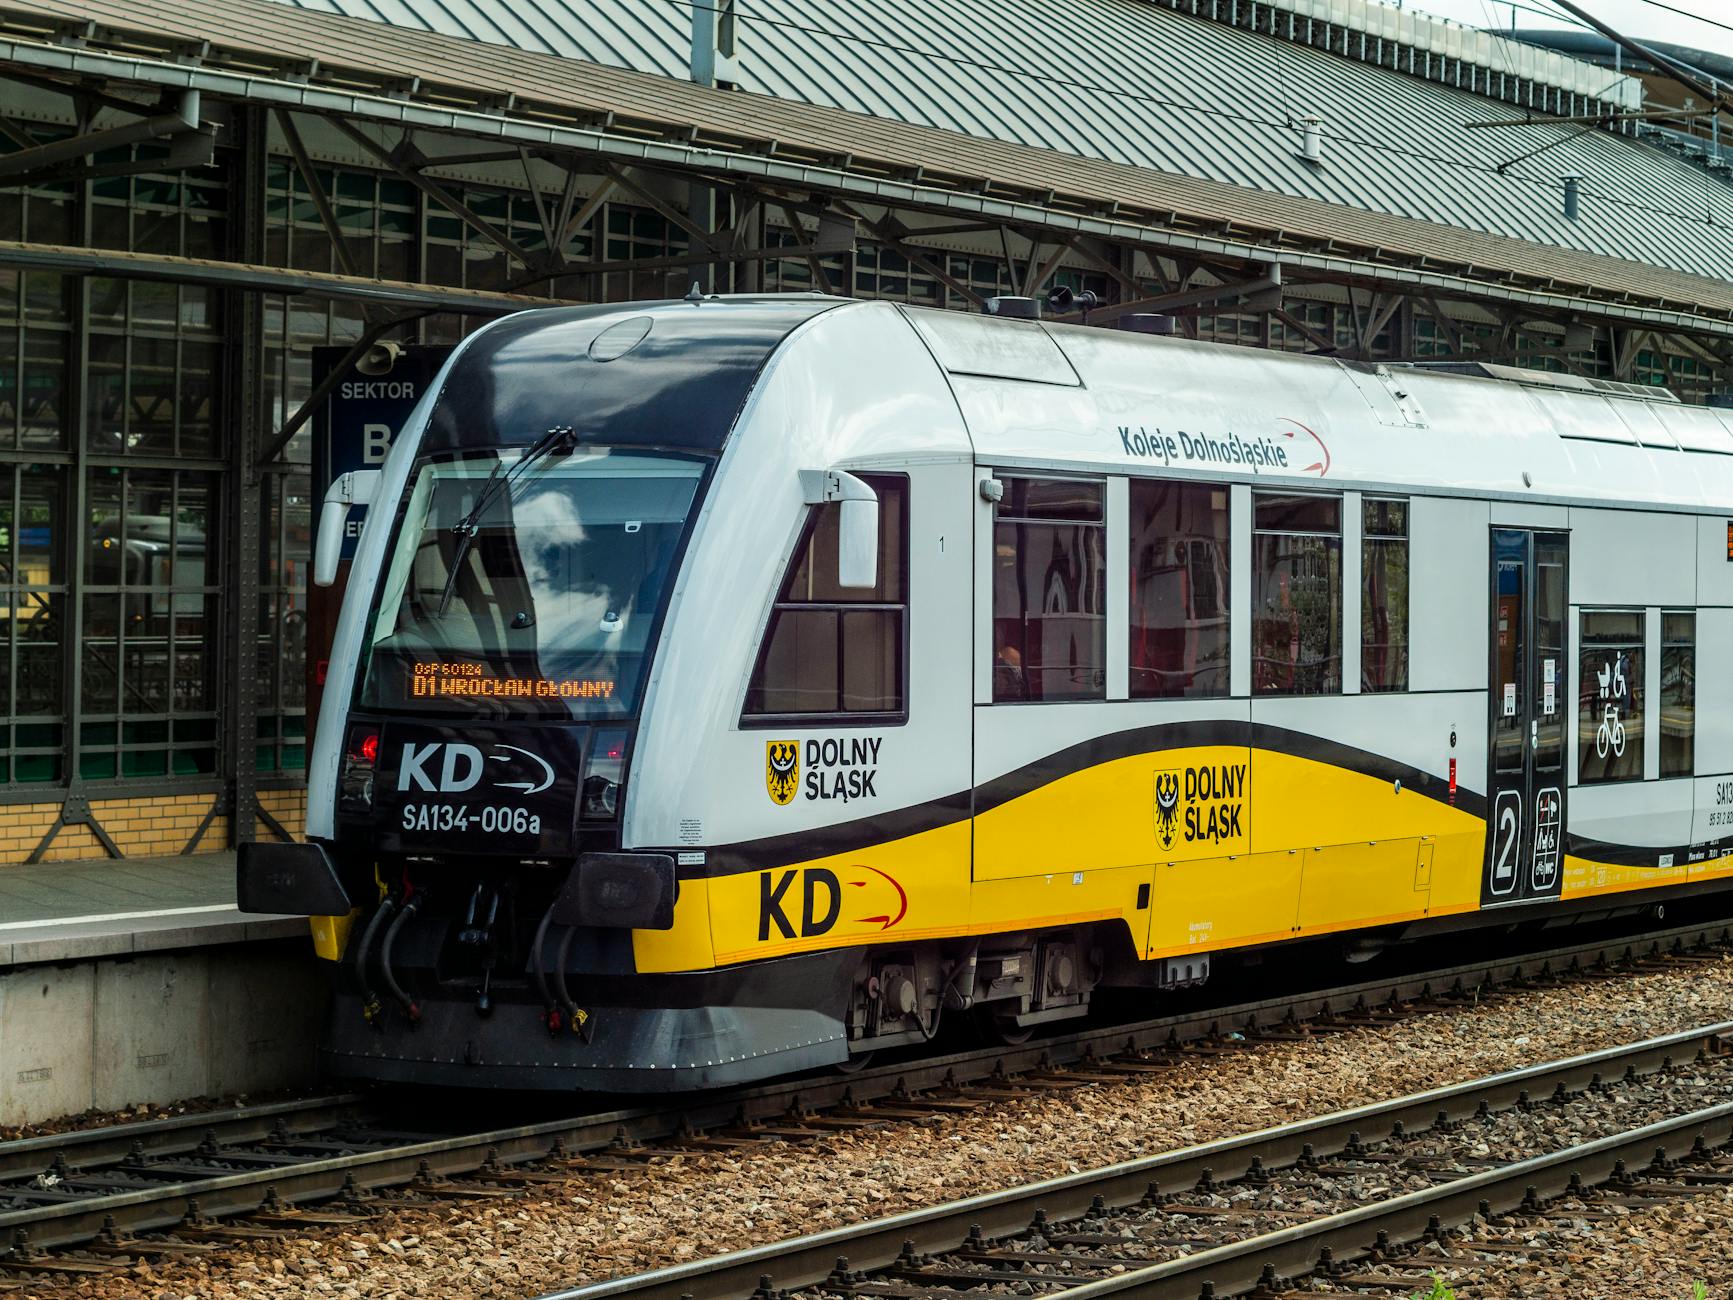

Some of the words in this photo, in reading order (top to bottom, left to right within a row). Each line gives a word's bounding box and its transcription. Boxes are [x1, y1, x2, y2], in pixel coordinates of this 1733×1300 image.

[341, 382, 415, 399] SEKTOR
[363, 423, 392, 464] B
[1118, 426, 1178, 466] Koleje
[1178, 431, 1288, 474] Dolnośląskie
[939, 536, 944, 553] 1
[413, 676, 436, 696] D1
[441, 678, 532, 696] WROCŁAW
[441, 664, 482, 676] 60124
[397, 743, 484, 792] KD
[806, 738, 882, 767] DOLNY
[805, 765, 876, 803] ŚLĄSK
[1185, 765, 1246, 801] DOLNY
[402, 804, 541, 834] SA134-006a
[1185, 799, 1242, 845] ŚLĄSK
[1496, 807, 1515, 878] 2
[758, 868, 841, 941] KD
